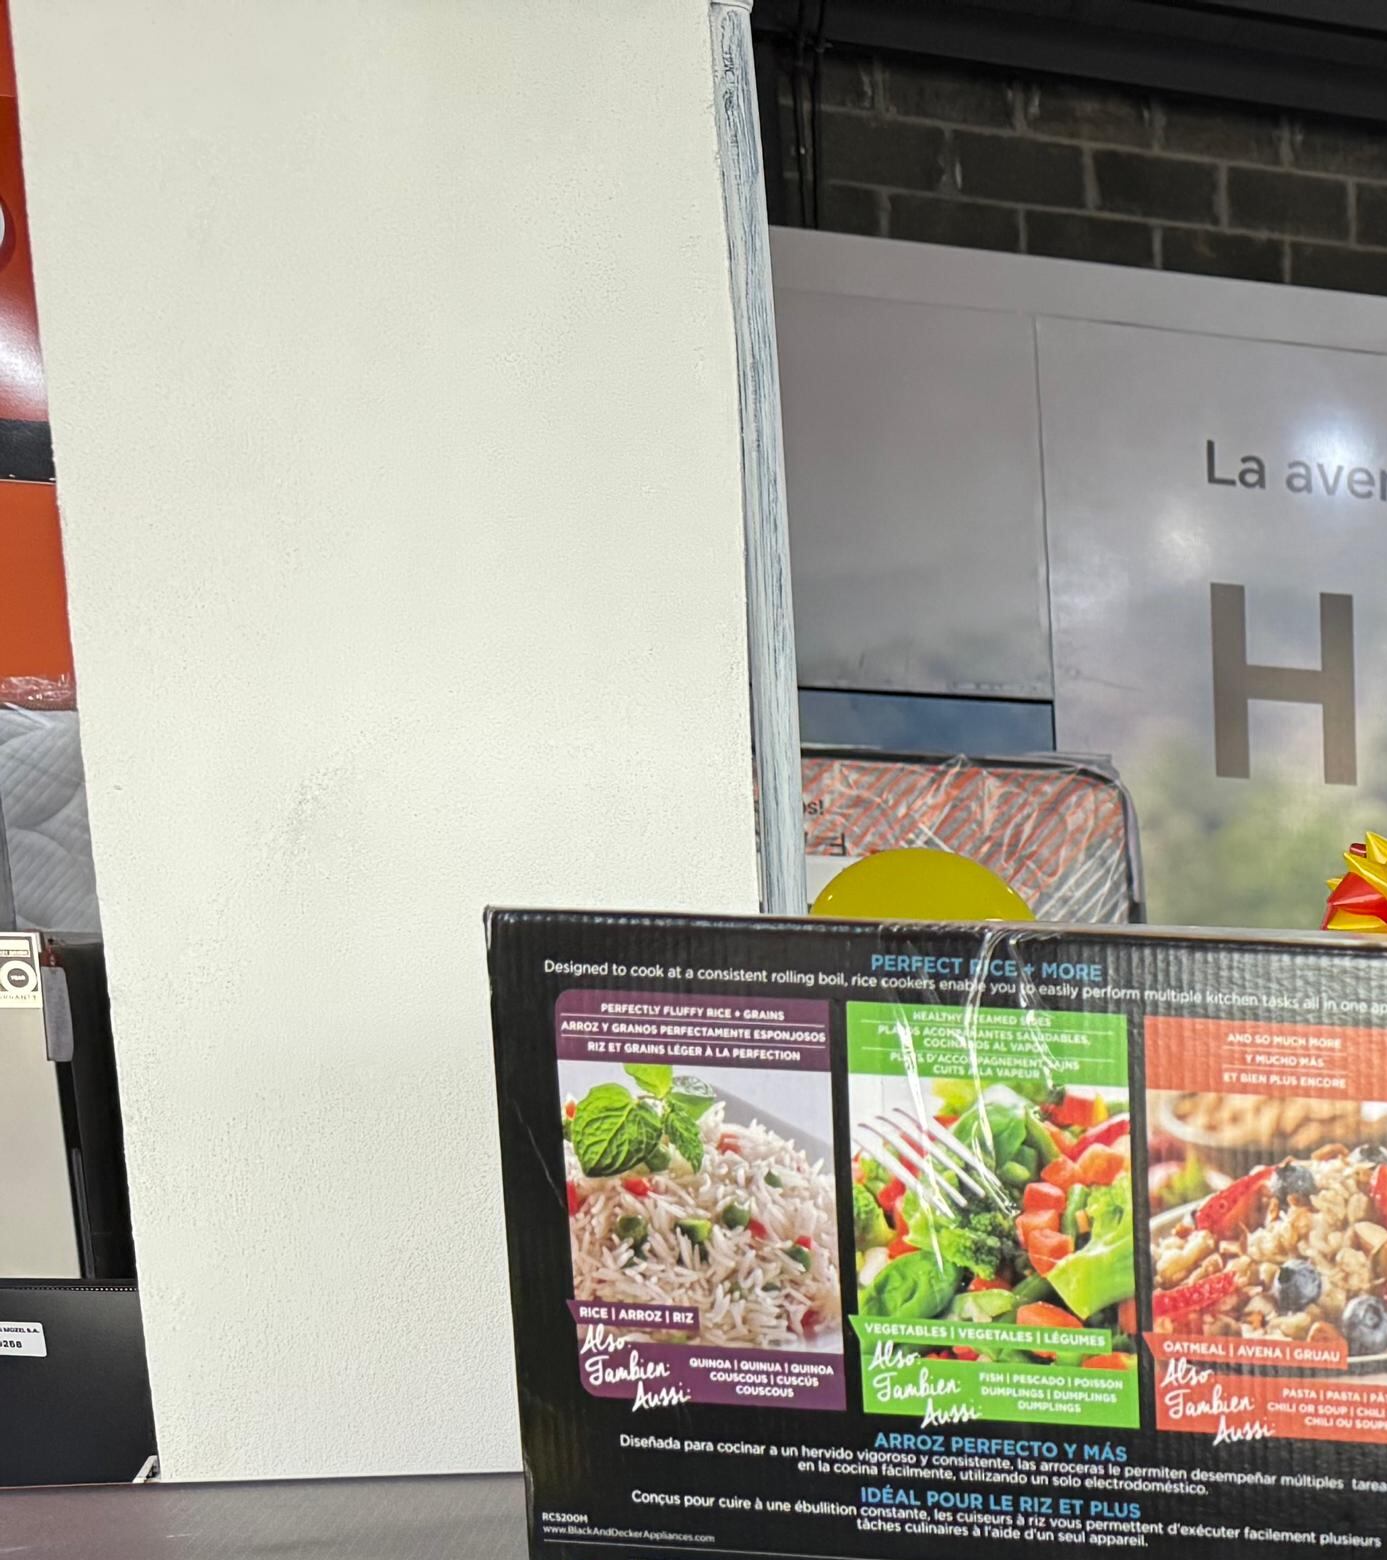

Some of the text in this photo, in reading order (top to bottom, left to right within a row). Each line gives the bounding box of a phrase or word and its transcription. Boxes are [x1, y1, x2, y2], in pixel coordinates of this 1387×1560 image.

[1206, 440, 1266, 489] La
[871, 953, 965, 976] PERFECT
[1041, 963, 1104, 982] MORE
[561, 1020, 826, 1043] ARROZ Y GRANOS PERFECTAMENTE ESPONJOSOS
[579, 1306, 694, 1324] RICE ARROZ RIZ
[865, 1322, 1106, 1347] VEGETABLES VEGETALES LÉGUMES
[1163, 1340, 1341, 1363] OATMEAL AVENA GRUAU
[689, 1358, 835, 1376] QUINOA QUINUA QUINOA
[873, 1431, 1128, 1462] ARROZ PERFECTO Y MÁS
[861, 1484, 1142, 1519] IDÉAL POUR LE RIZ ET PLUS
